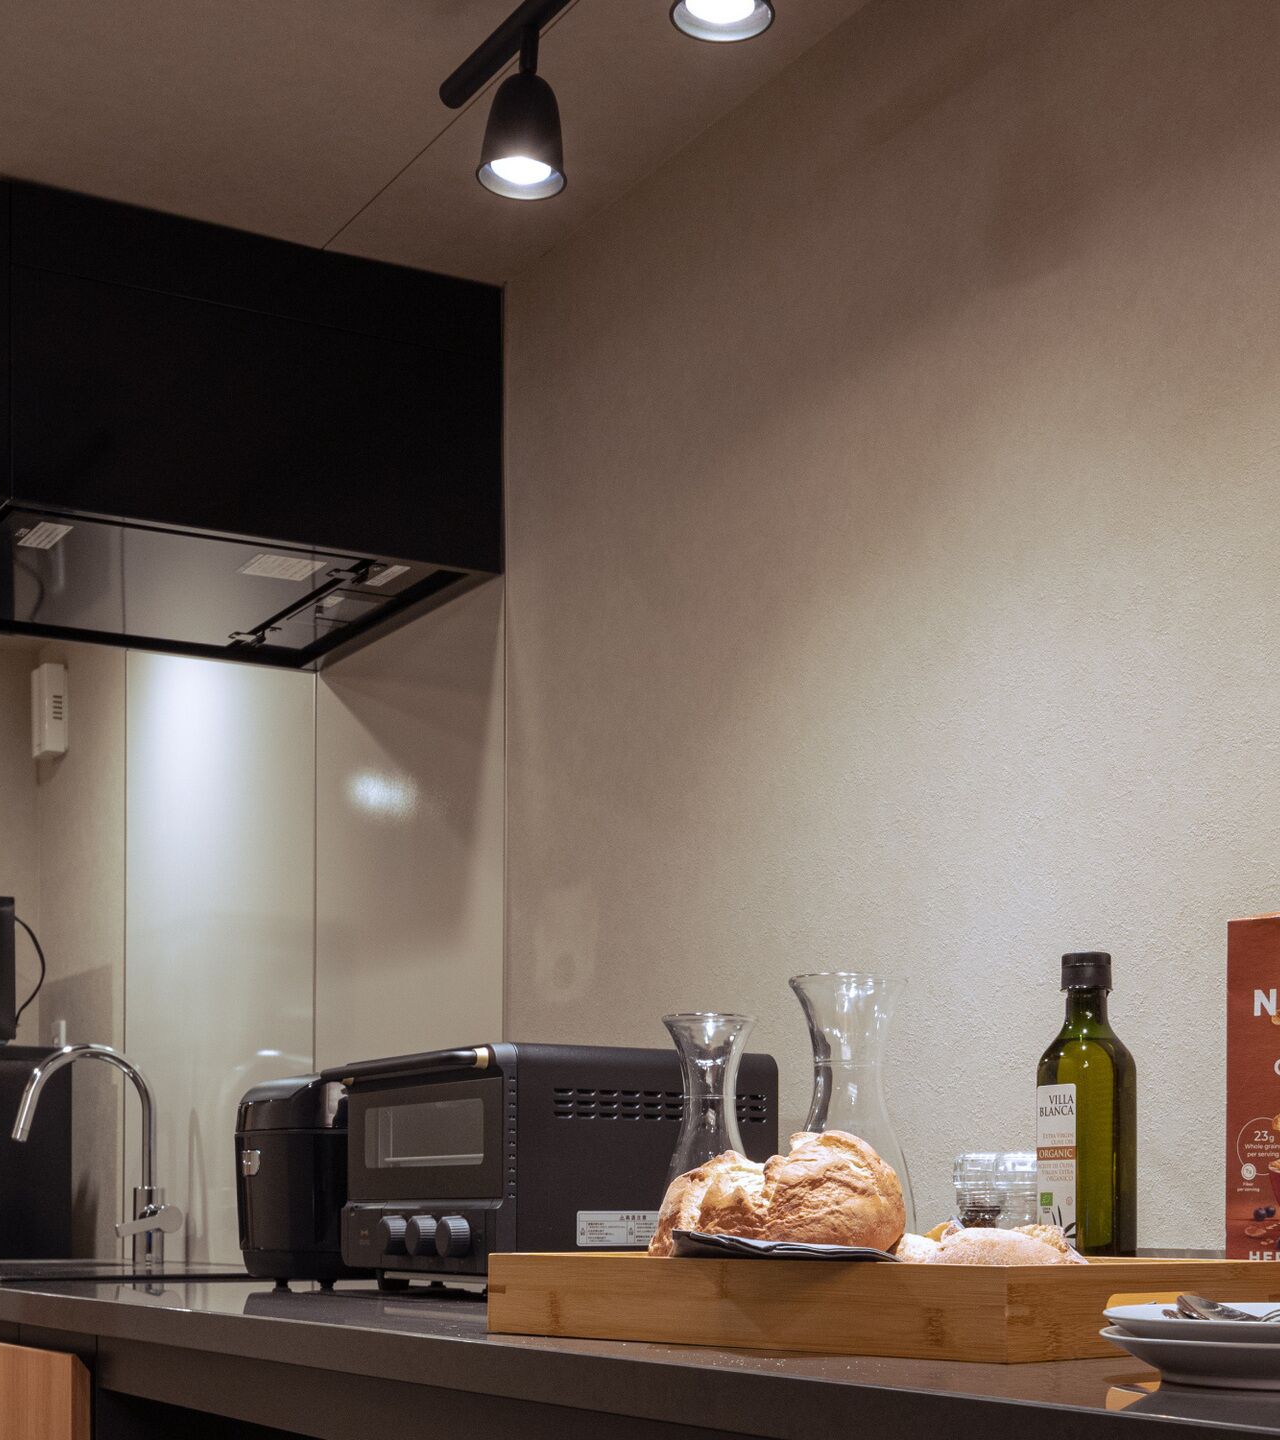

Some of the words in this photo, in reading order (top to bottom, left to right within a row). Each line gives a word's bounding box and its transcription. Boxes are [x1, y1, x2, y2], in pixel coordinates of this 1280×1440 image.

[1048, 1093, 1074, 1105] VILLA
[1039, 1105, 1074, 1118] BLANCA
[1039, 1148, 1073, 1159] ORGANIC
